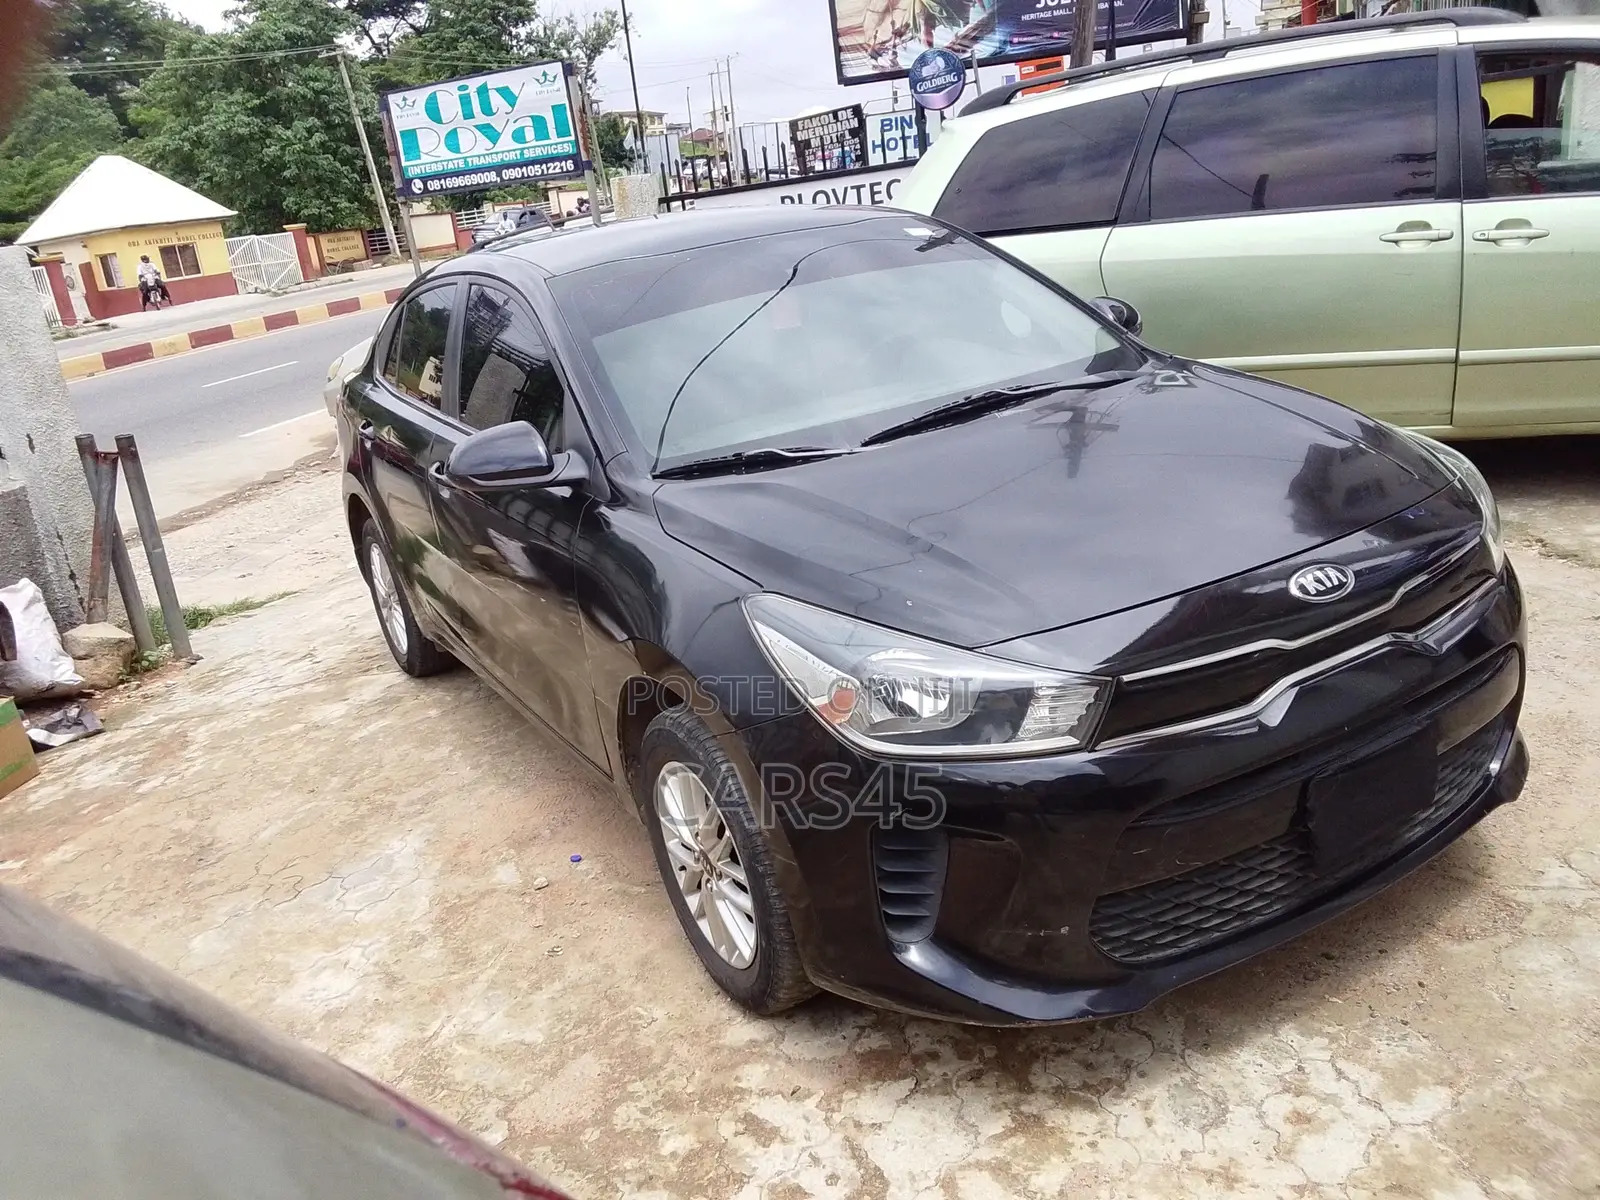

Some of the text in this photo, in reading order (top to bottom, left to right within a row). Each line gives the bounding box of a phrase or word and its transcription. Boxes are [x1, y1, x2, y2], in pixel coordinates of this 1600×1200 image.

[1021, 10, 1053, 21] HERITAGE
[1097, 0, 1124, 10] IBAAN.
[916, 72, 958, 92] GOLDBERG
[424, 81, 526, 125] City
[399, 103, 573, 162] Royal
[796, 117, 859, 141] MERIDIAN
[797, 108, 855, 131] FAKOL DE
[408, 142, 573, 177] (INTERSTATE TRANSPORT SERVICES)
[427, 160, 574, 191] 08169669008, 09010512216
[176, 234, 196, 243] MODEL
[198, 231, 224, 241] COLLEGE
[1297, 567, 1348, 595] KIA
